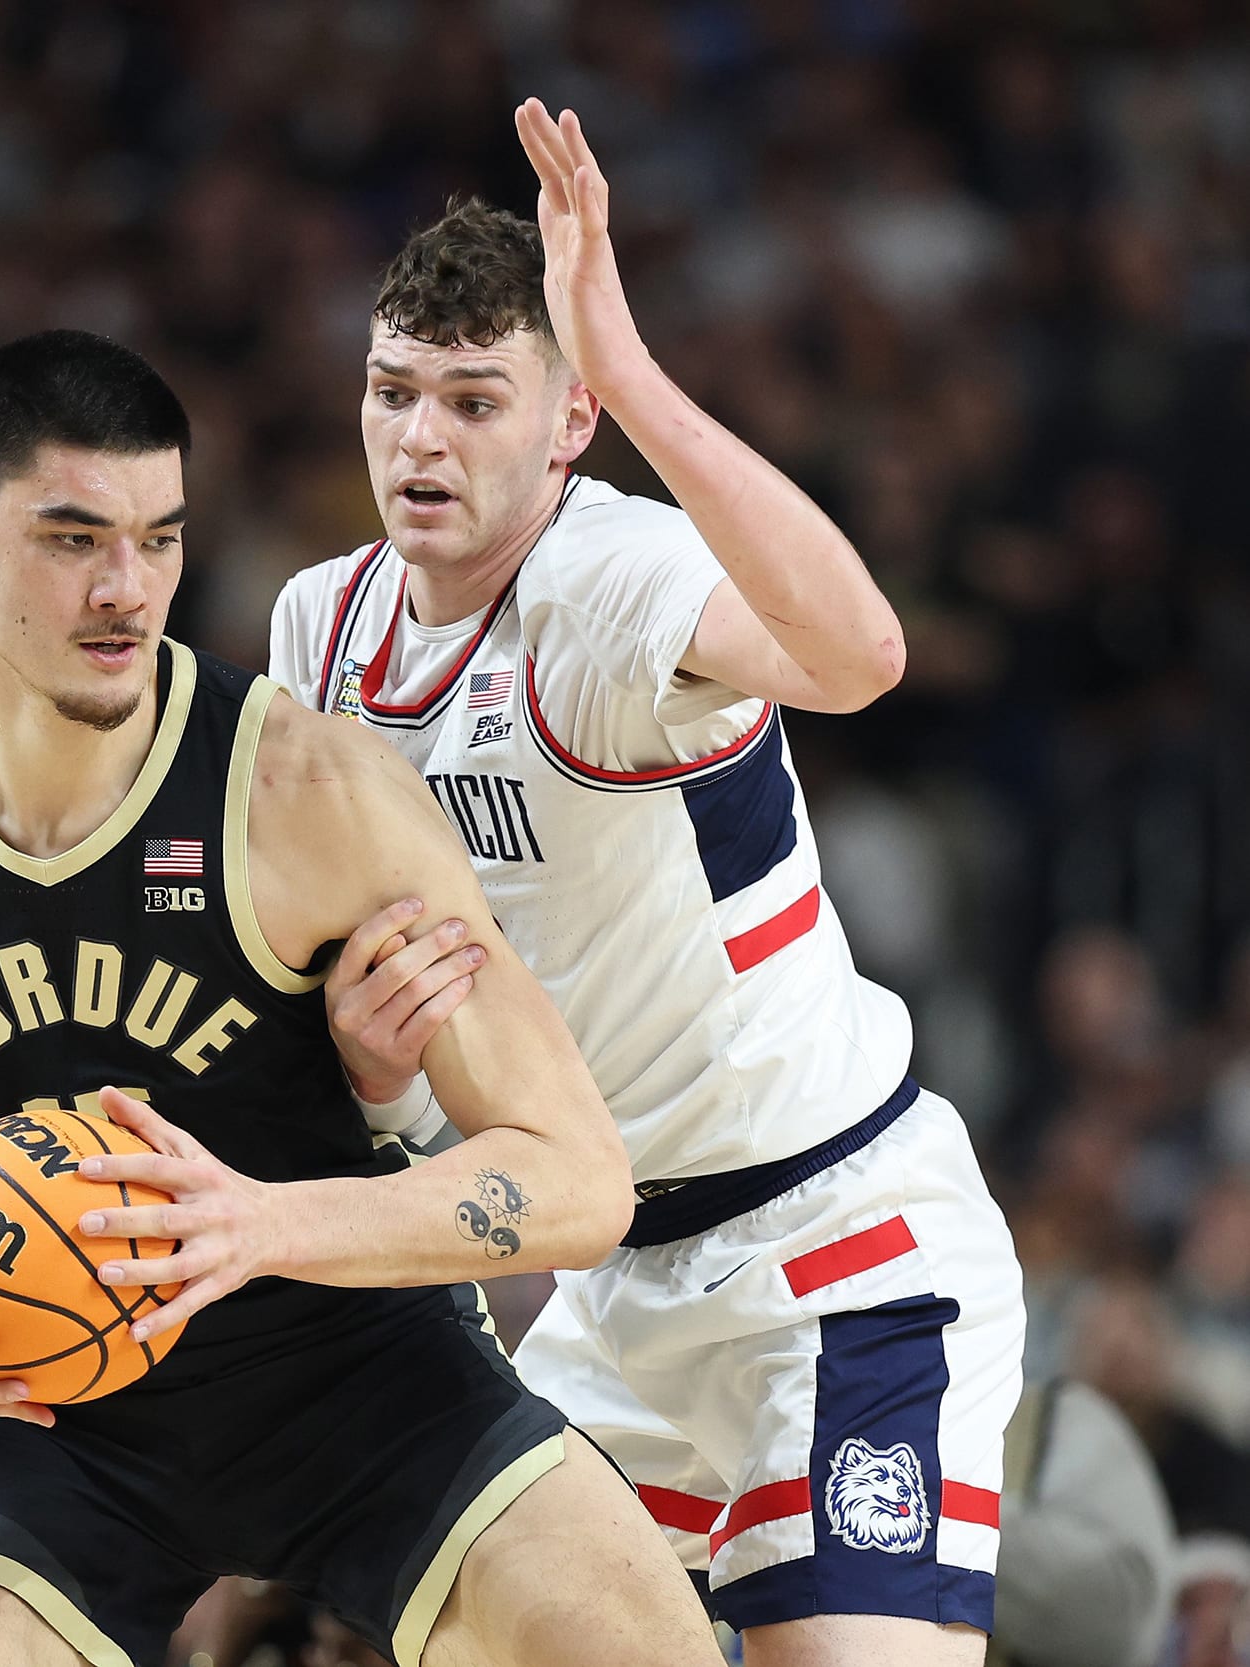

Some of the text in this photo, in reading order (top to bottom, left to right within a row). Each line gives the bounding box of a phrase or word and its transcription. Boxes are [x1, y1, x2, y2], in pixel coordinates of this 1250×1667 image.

[342, 673, 362, 690] FIN
[338, 687, 361, 704] FOU
[476, 712, 503, 729] BIG
[471, 722, 513, 742] EAST
[426, 773, 545, 863] TICUT
